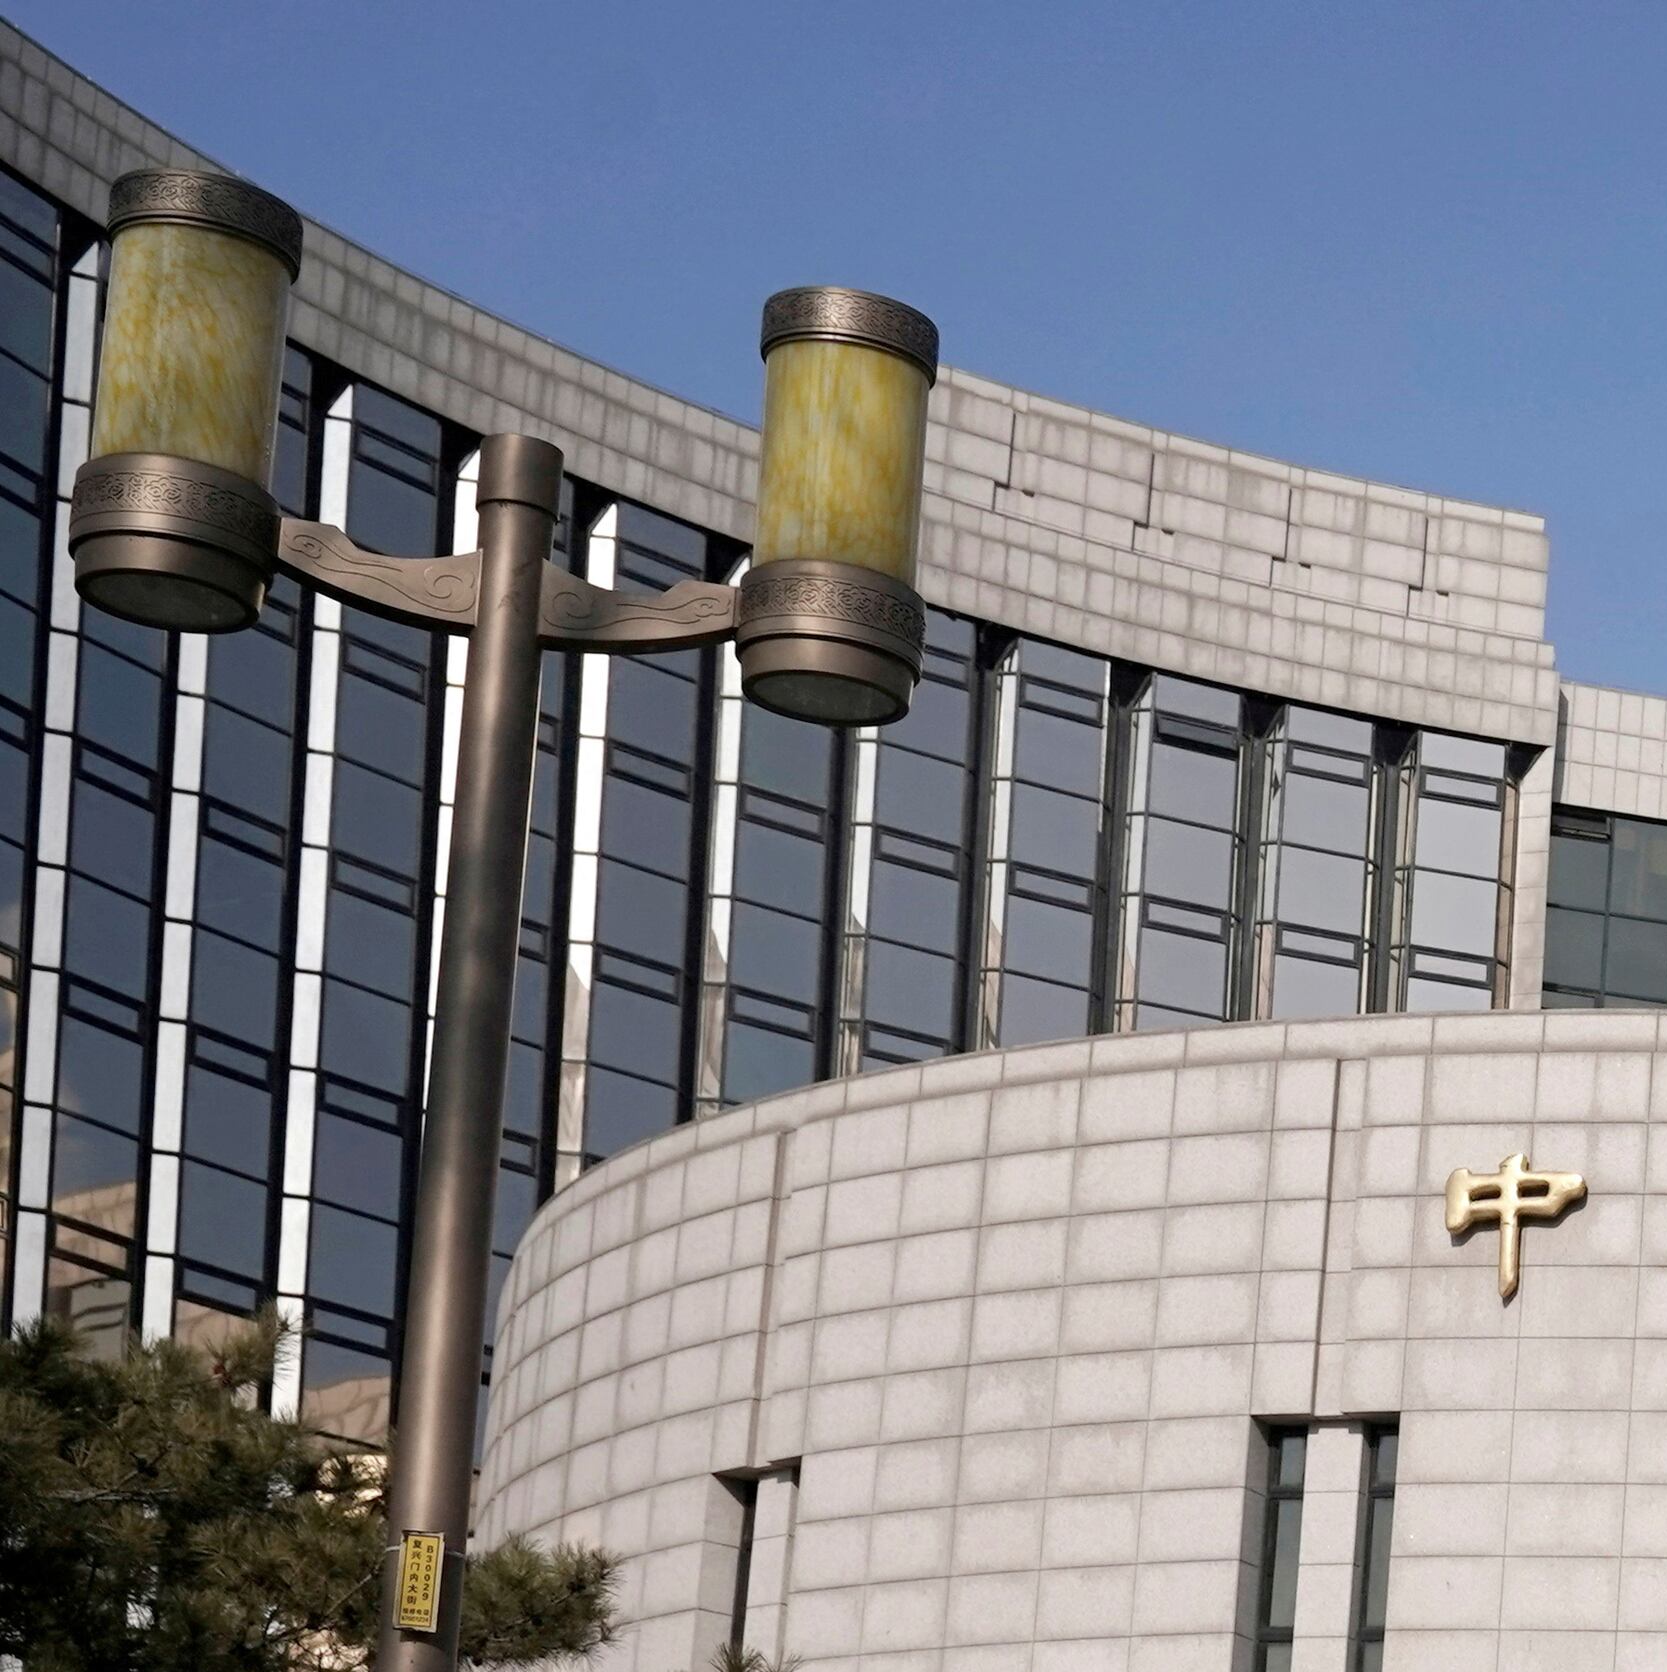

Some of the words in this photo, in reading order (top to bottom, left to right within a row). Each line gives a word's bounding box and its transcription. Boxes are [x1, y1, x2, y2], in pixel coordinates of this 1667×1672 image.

[407, 1540, 422, 1605] 复兴门内大街
[422, 1545, 434, 1601] B30029
